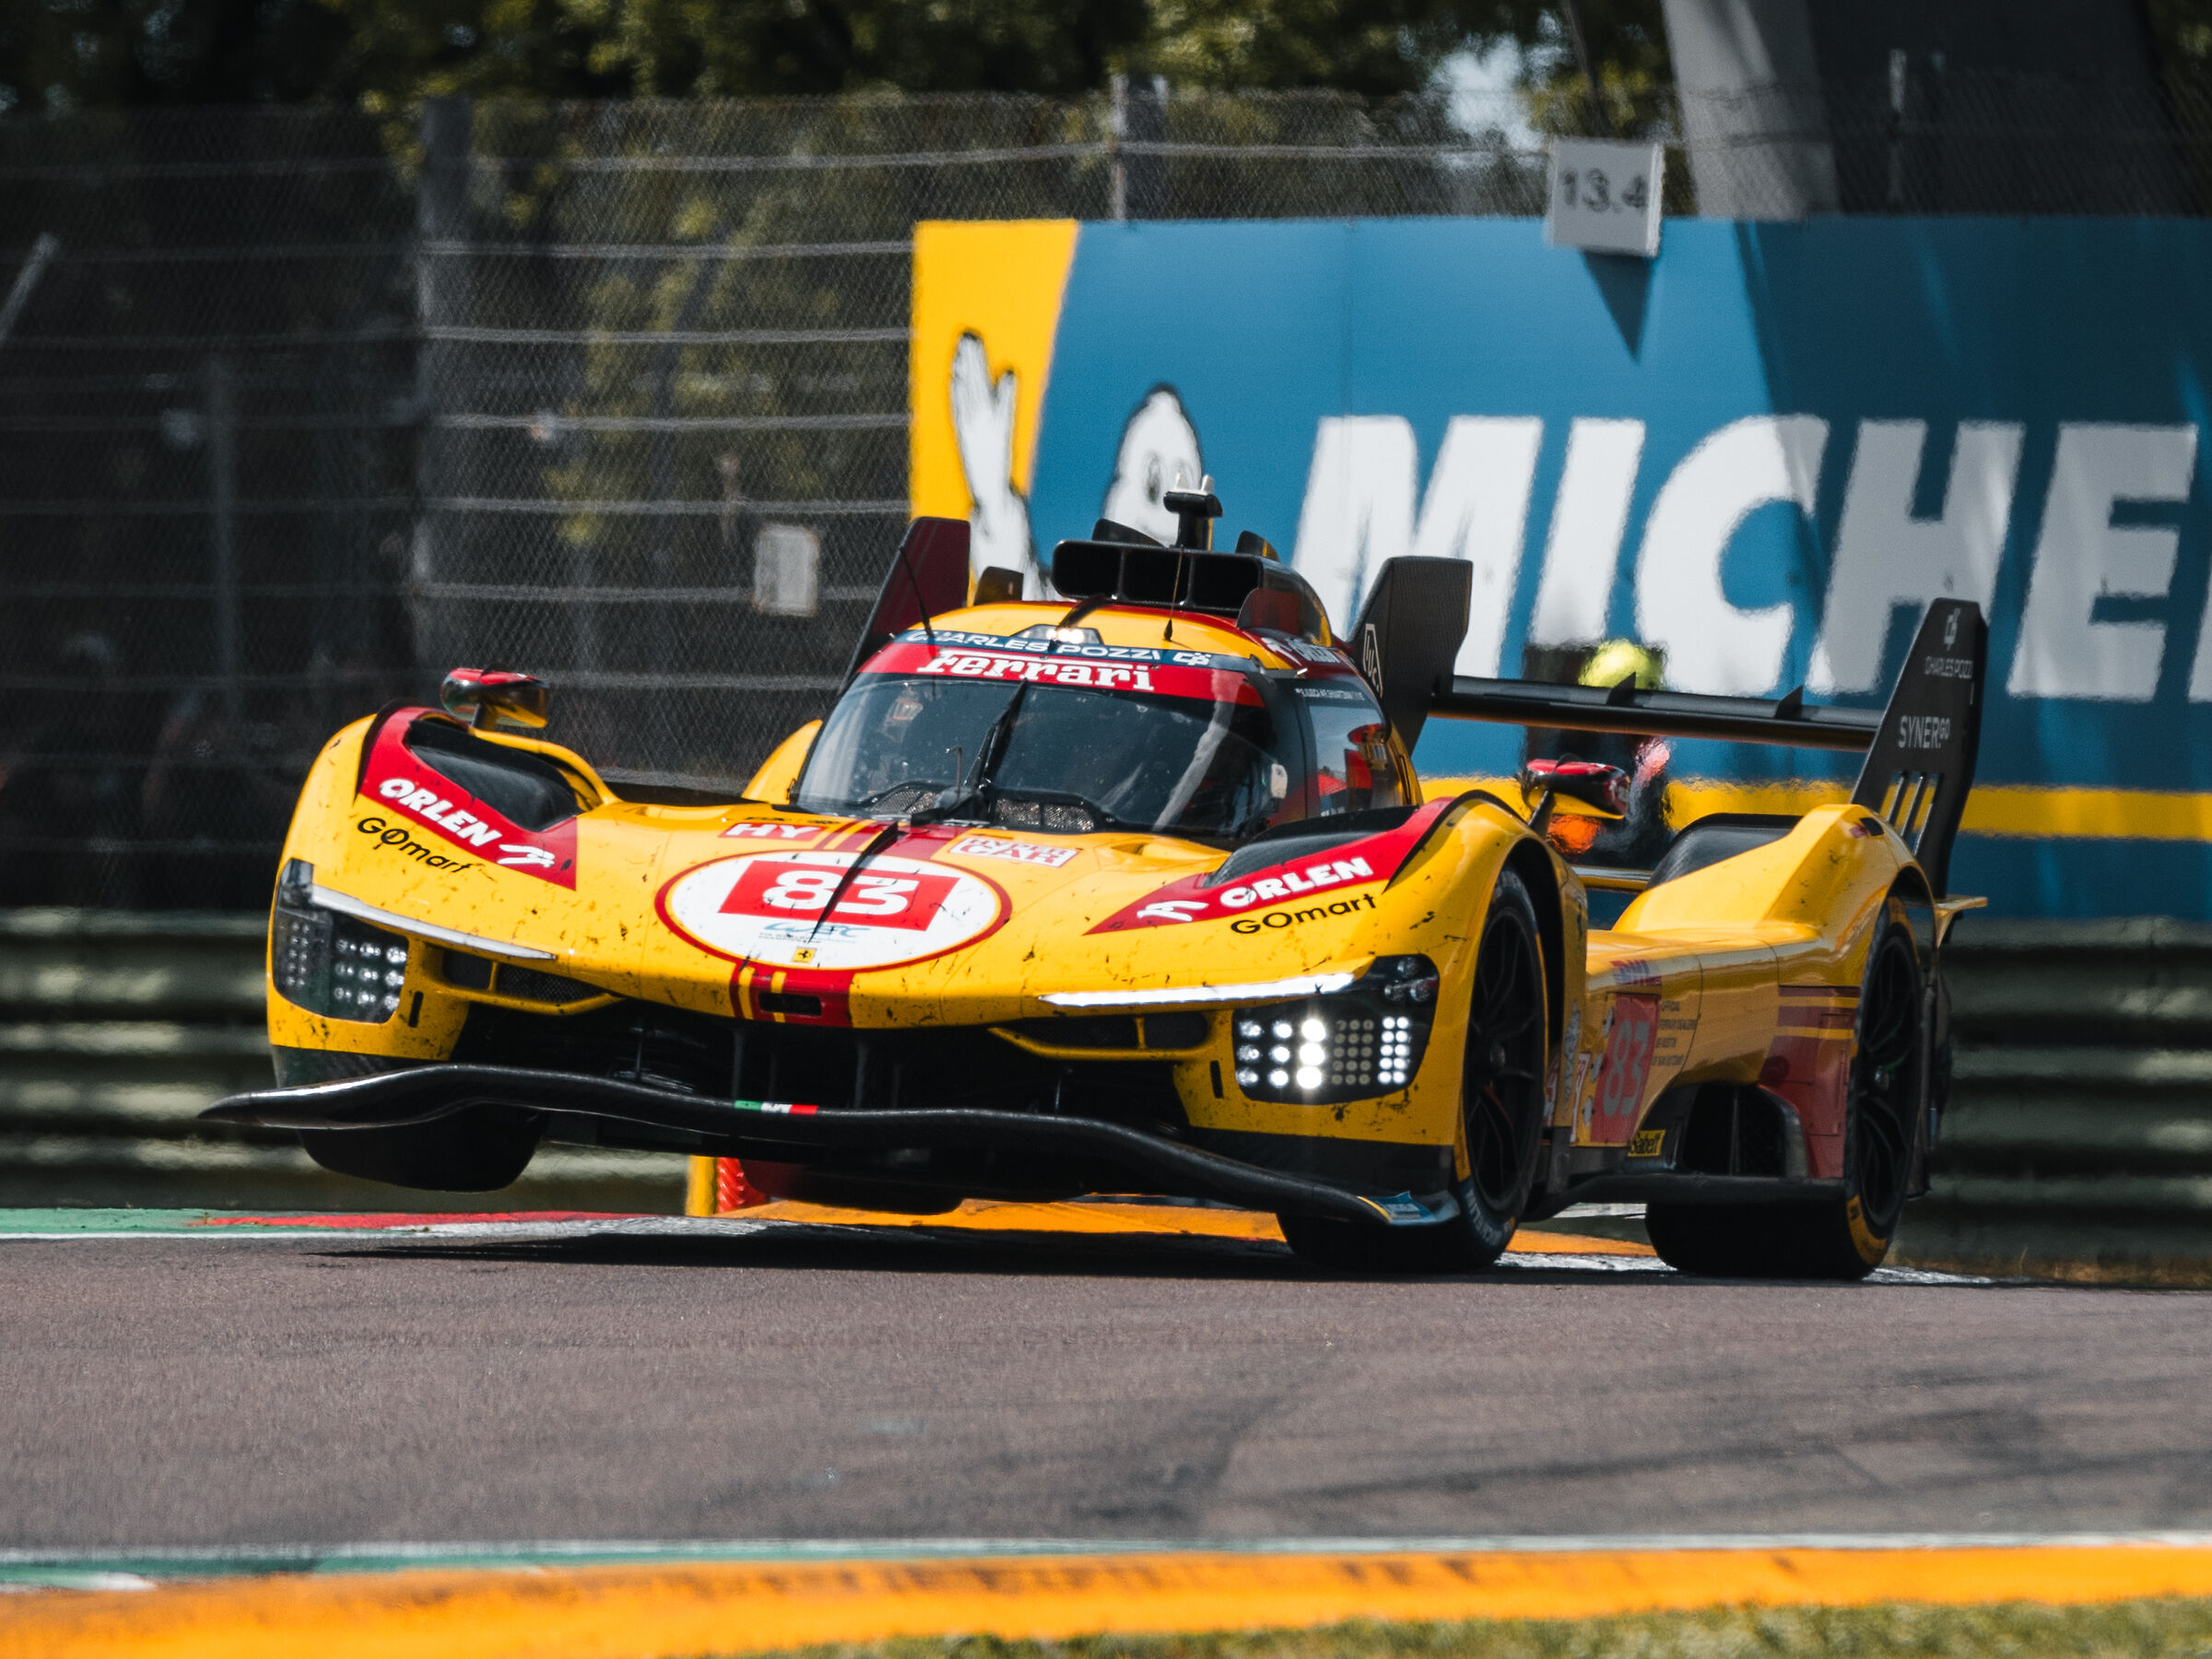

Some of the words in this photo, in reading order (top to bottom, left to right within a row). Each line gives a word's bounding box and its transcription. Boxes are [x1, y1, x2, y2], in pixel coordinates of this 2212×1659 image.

[1559, 168, 1649, 216] 13.4
[1290, 414, 2212, 703] MICHE
[916, 647, 1155, 691] Ferrari
[1056, 645, 1161, 661] POZZI
[378, 778, 503, 847] ORLEN
[728, 823, 815, 839] HY
[357, 817, 474, 873] GOmart
[959, 843, 1060, 865] CAR
[762, 869, 919, 916] 83
[1219, 856, 1374, 909] ORLEN
[1230, 893, 1377, 934] GOmart
[1602, 1020, 1651, 1117] 83
